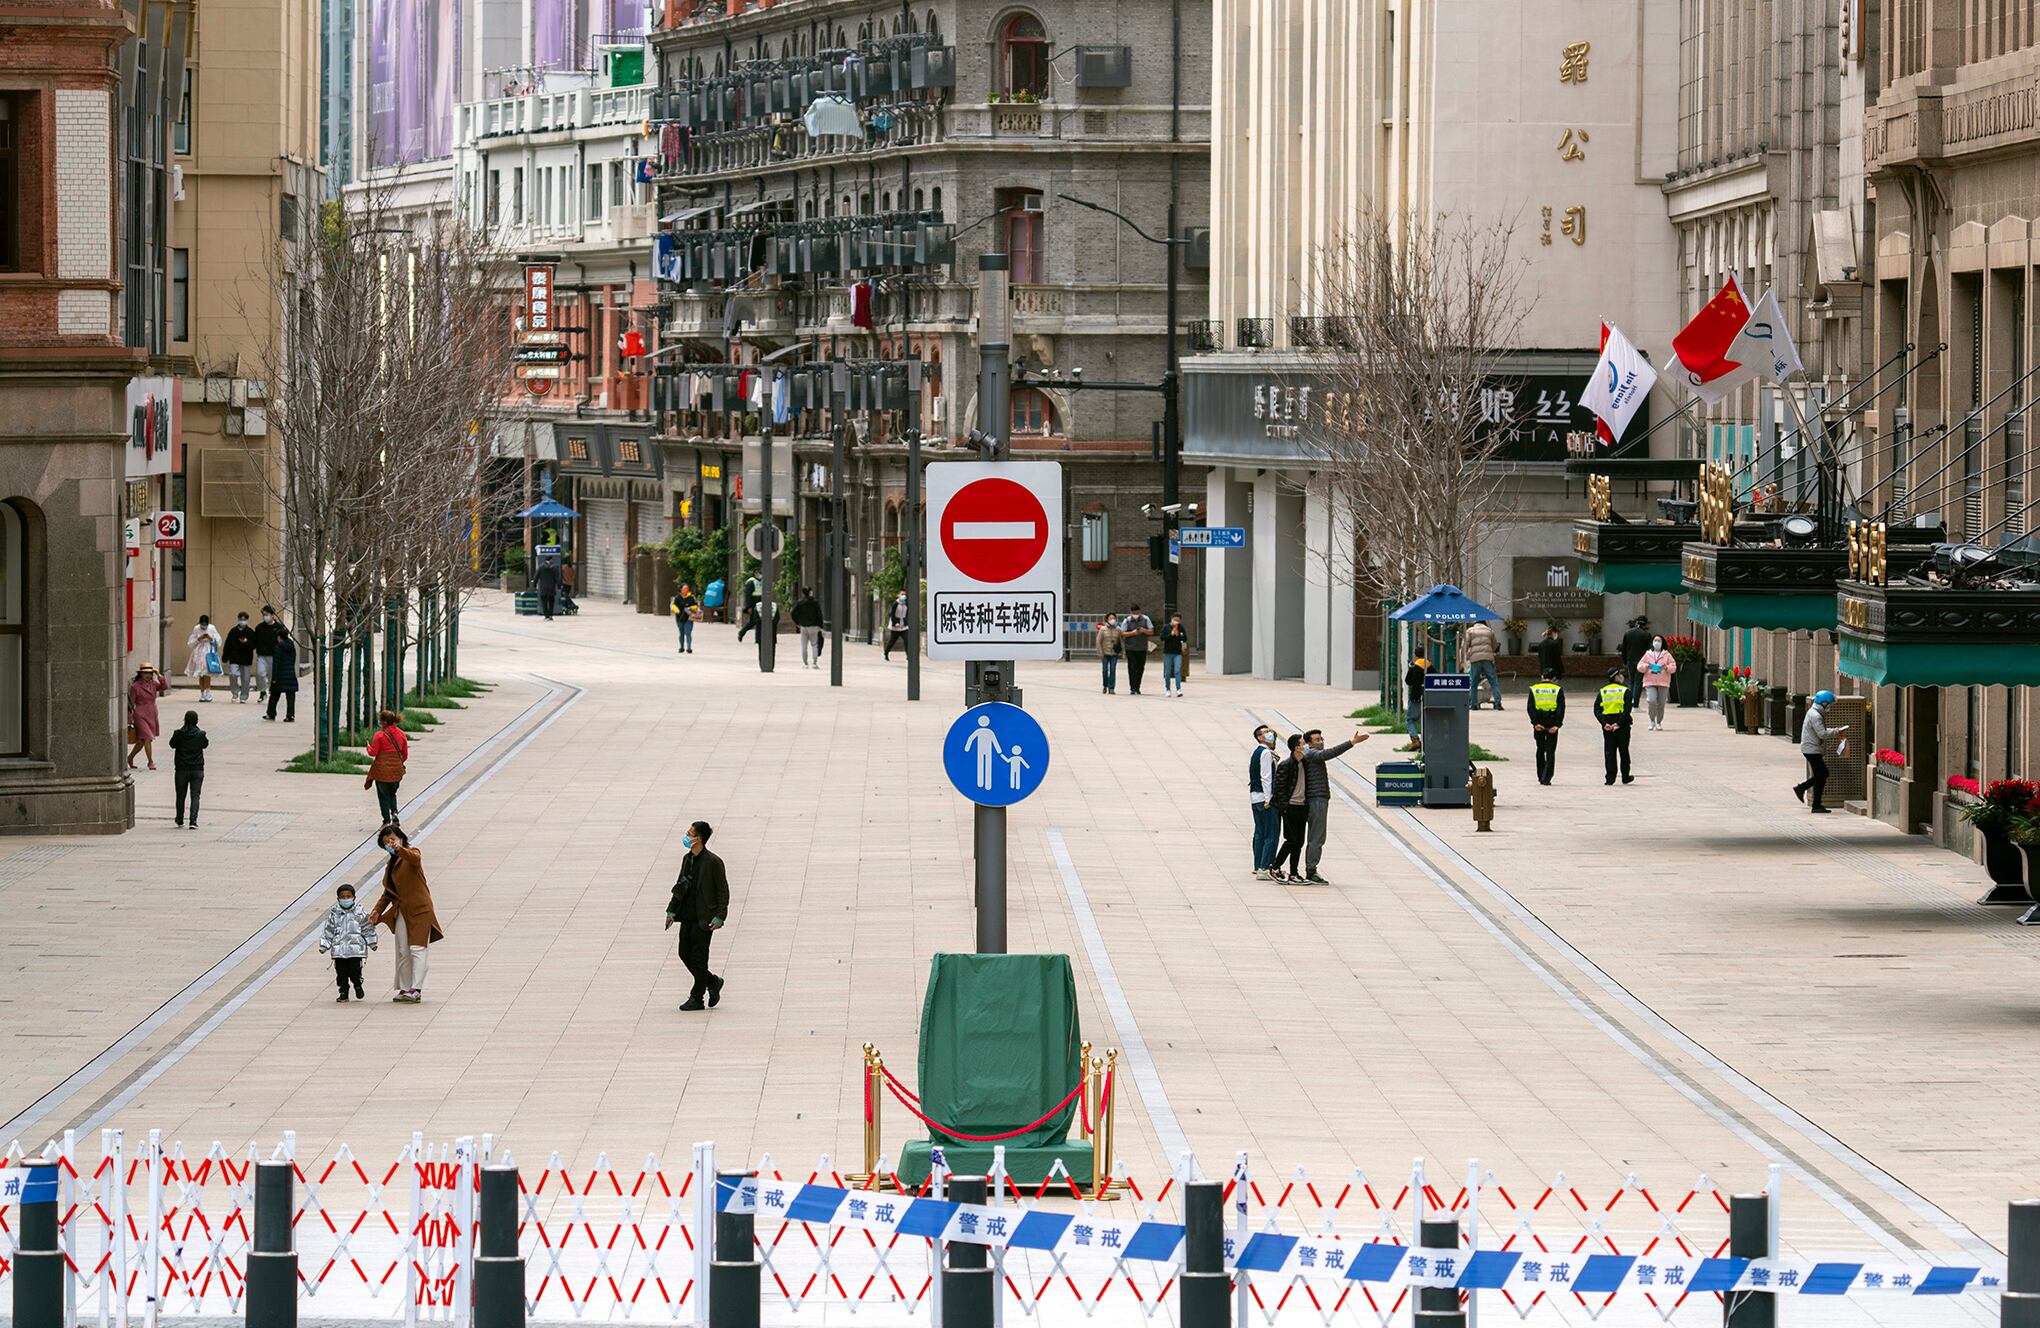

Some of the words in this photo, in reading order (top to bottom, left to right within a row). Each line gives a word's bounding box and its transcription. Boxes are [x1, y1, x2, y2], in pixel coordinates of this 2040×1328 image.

[161, 519, 177, 532] 24
[940, 602, 1049, 634] 除特种车辆外
[848, 1199, 896, 1224] 警戒
[958, 1212, 1008, 1238] 警戒
[1073, 1224, 1122, 1249] 警戒
[1298, 1246, 1345, 1270] 警戒
[1408, 1255, 1456, 1278] 警戒
[1522, 1261, 1571, 1283] 警戒
[1637, 1264, 1685, 1286] 警戒
[1751, 1268, 1799, 1287] 警戒
